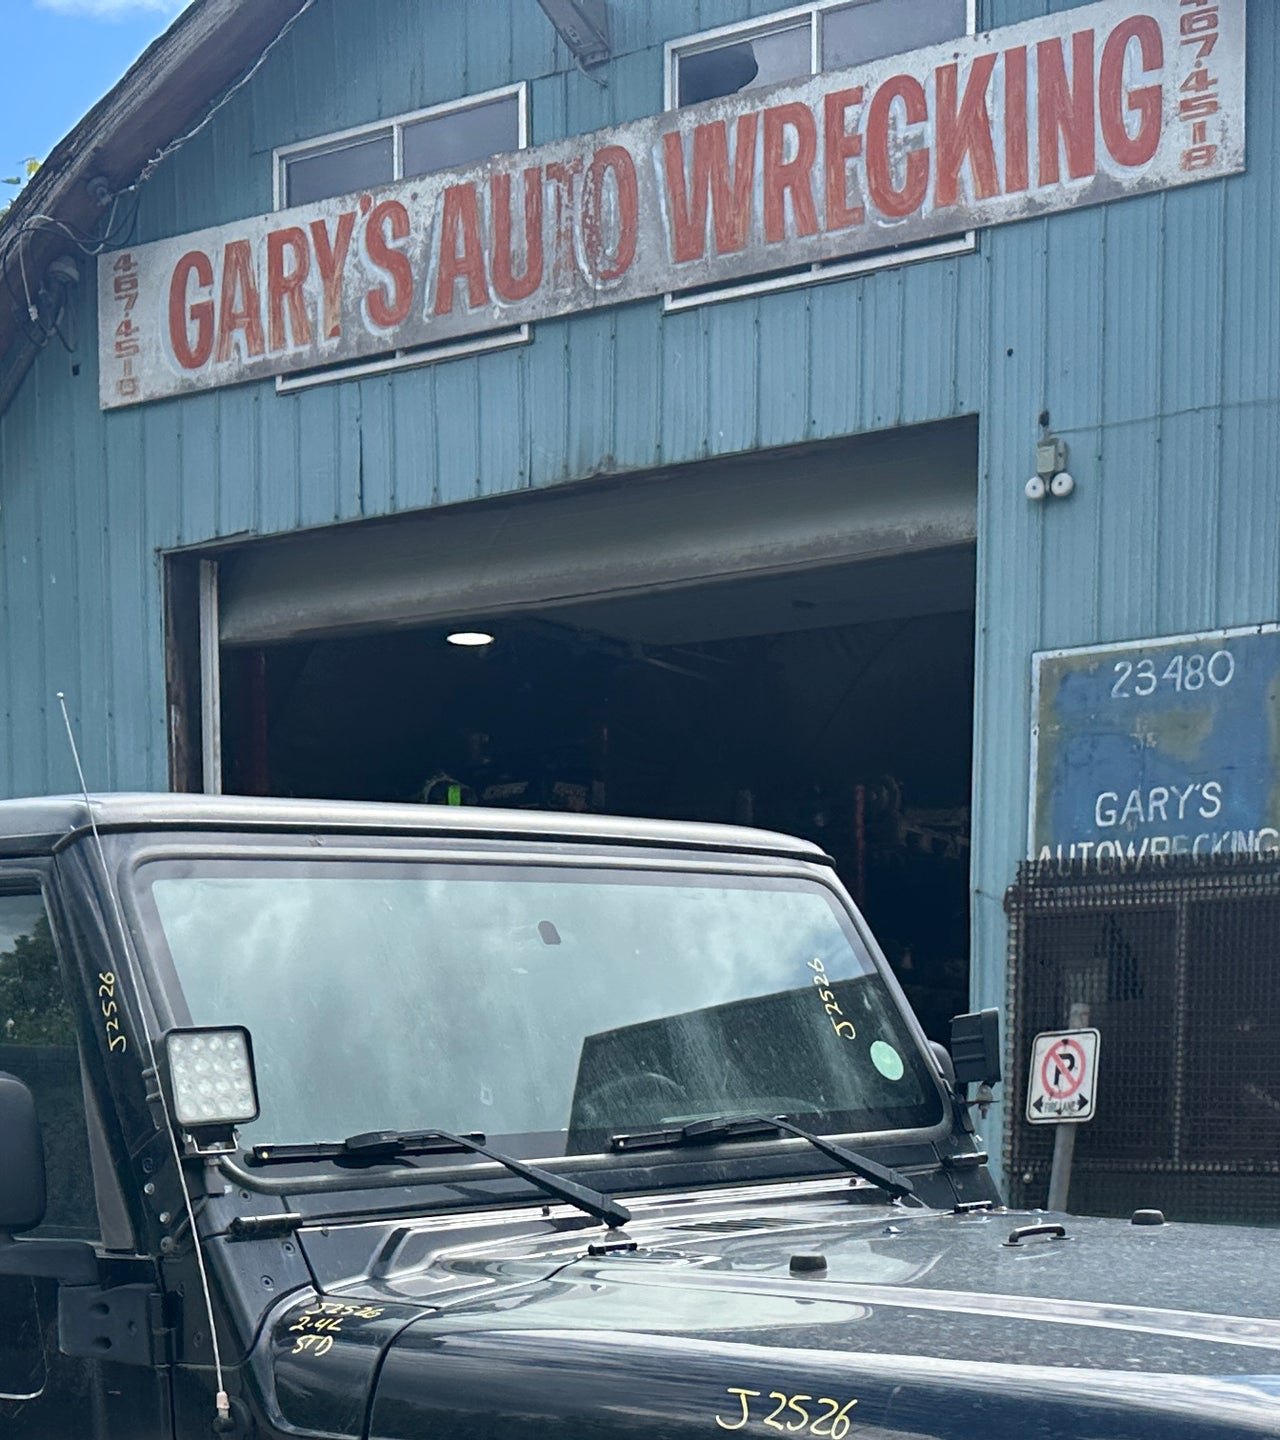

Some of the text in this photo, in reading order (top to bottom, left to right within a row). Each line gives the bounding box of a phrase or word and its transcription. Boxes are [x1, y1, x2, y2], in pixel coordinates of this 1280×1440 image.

[168, 14, 1165, 370] GARY'S AUTO WRECKING
[1111, 649, 1235, 699] 23480
[1095, 780, 1223, 828] GARY'S
[98, 971, 127, 1053] J2526
[807, 957, 857, 1041] J2526
[291, 1334, 334, 1357] STD
[715, 1387, 859, 1440] J2526
